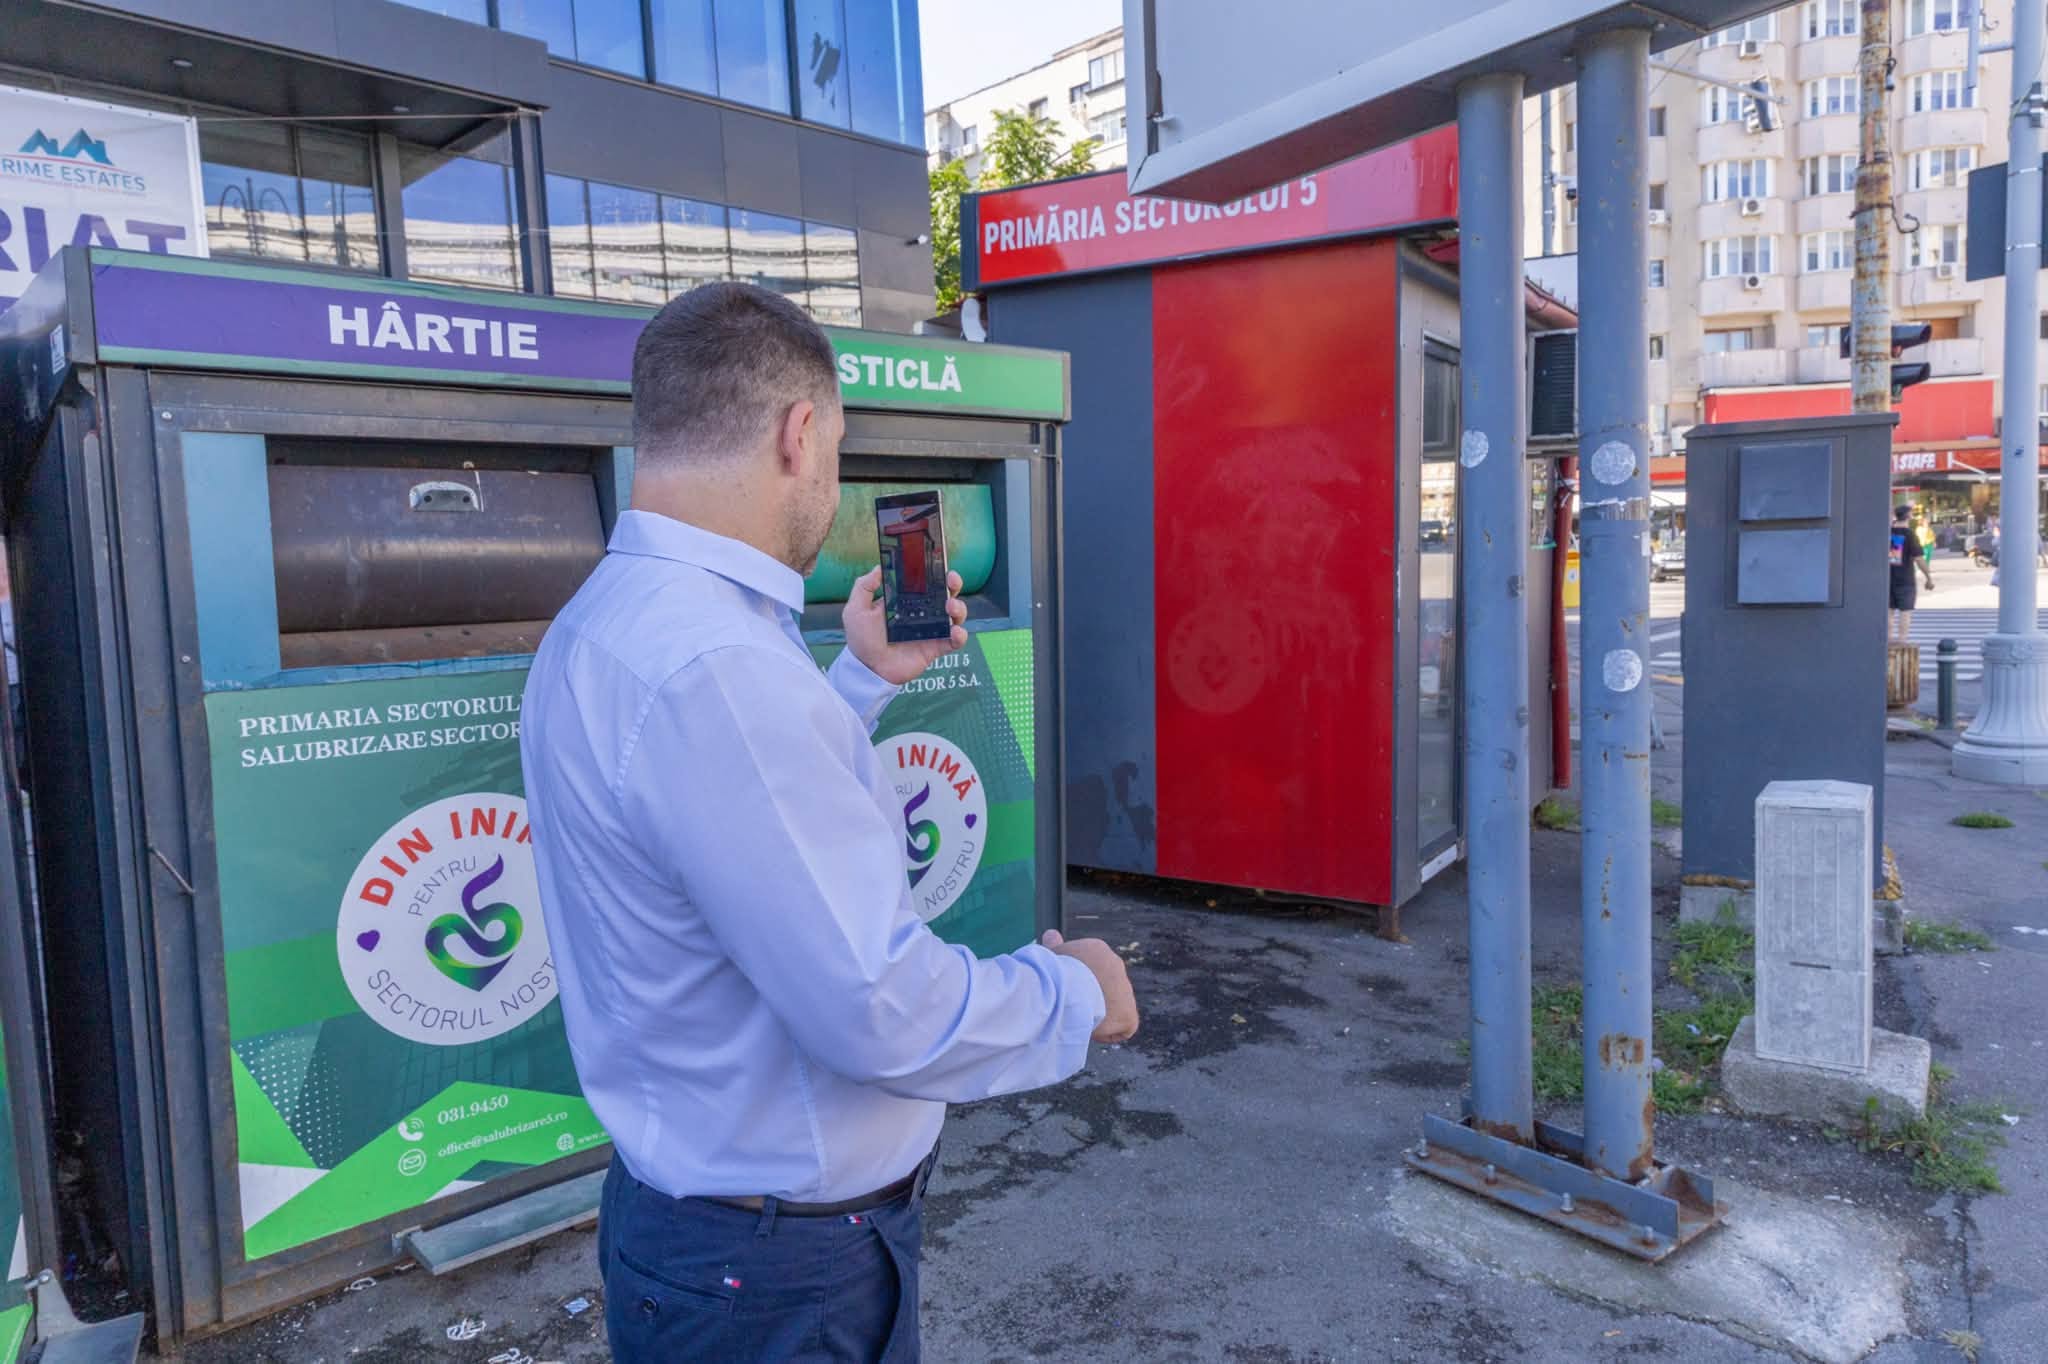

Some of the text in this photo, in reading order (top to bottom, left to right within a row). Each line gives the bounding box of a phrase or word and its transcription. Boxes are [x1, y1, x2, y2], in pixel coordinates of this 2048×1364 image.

[60, 166, 147, 192] ESTATES
[984, 204, 1107, 254] PRIMĂRIA
[1300, 174, 1318, 207] 5
[328, 301, 540, 360] HÂRTIE
[838, 353, 962, 393] STICLĂ
[948, 675, 956, 689] 5
[958, 673, 981, 688] S.A.
[962, 653, 970, 668] 5
[239, 693, 525, 738] PRIMARIA SECTORUL
[241, 721, 521, 768] SALUBRIZARE SECTOR
[897, 744, 977, 802] INIMĂ
[359, 826, 435, 908] DIN
[407, 855, 477, 918] PENTRU
[924, 840, 976, 911] NOSTRU
[367, 968, 494, 1031] SECTORUL
[437, 1094, 509, 1126] 081.9450
